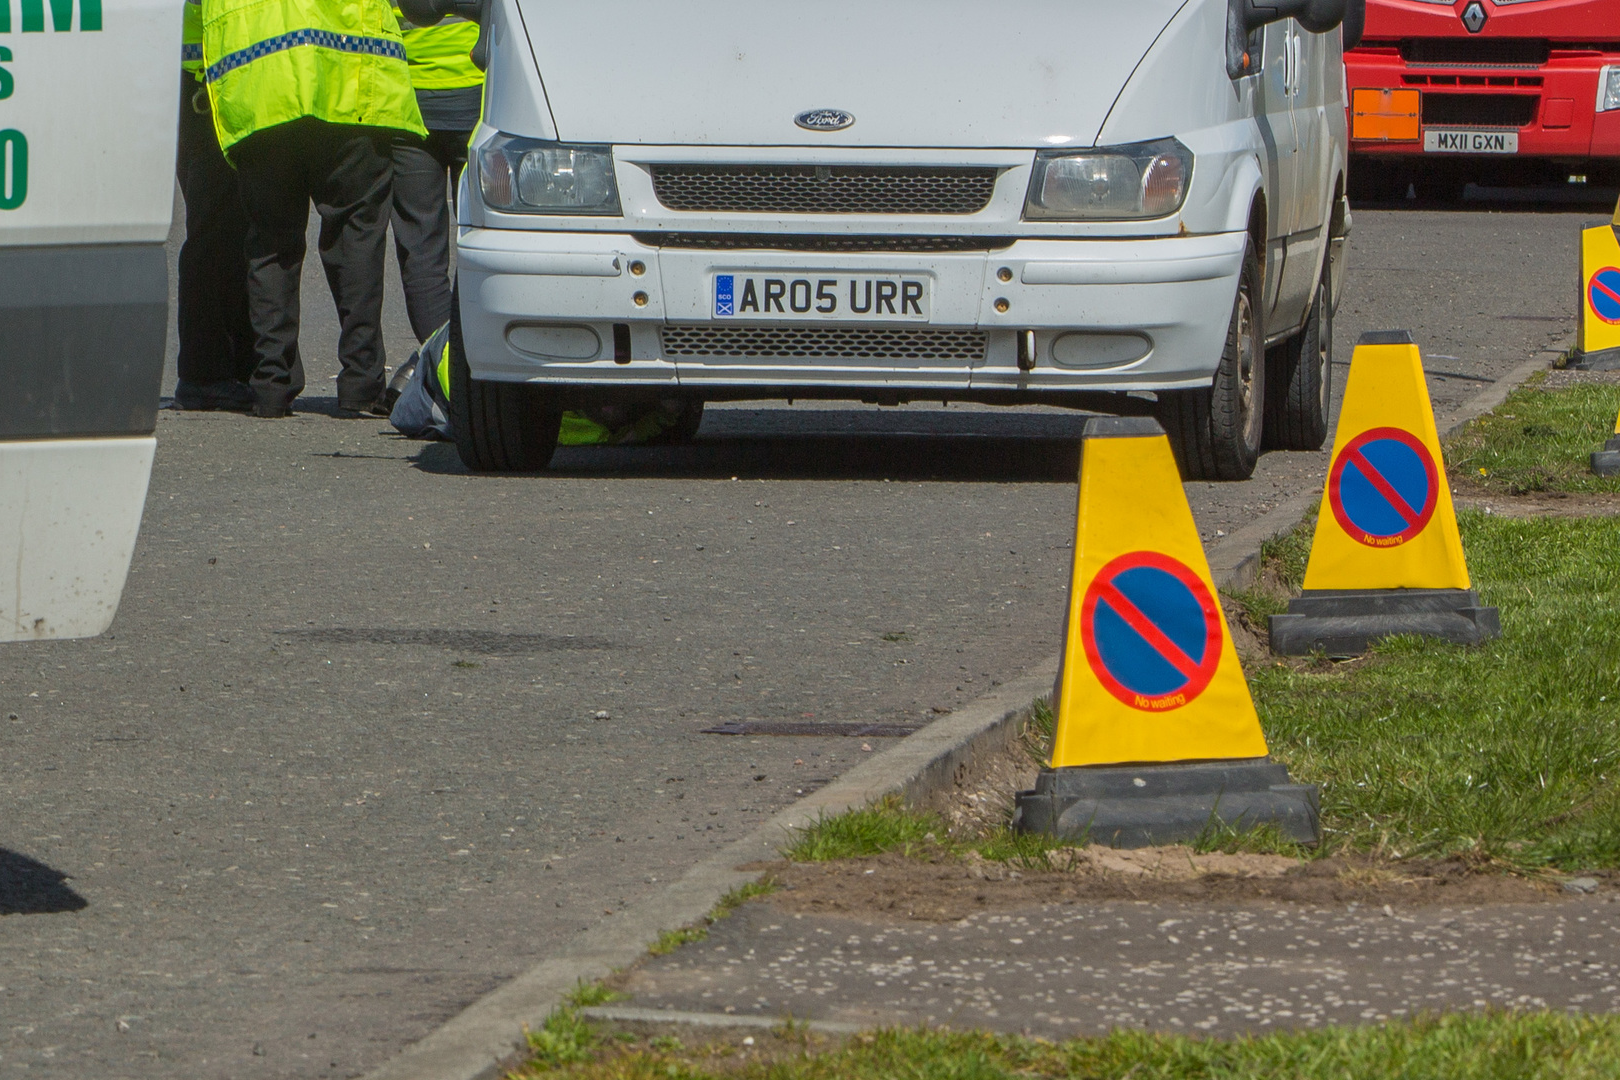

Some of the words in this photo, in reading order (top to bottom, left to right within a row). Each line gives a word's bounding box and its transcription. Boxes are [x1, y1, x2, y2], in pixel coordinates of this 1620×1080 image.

[806, 113, 841, 126] Ford
[1473, 135, 1504, 150] GXN
[739, 278, 838, 314] AR05
[849, 280, 924, 315] URR
[1363, 533, 1376, 545] No
[1376, 535, 1404, 546] waiting
[1134, 694, 1150, 708] No
[1150, 692, 1186, 709] waiting
